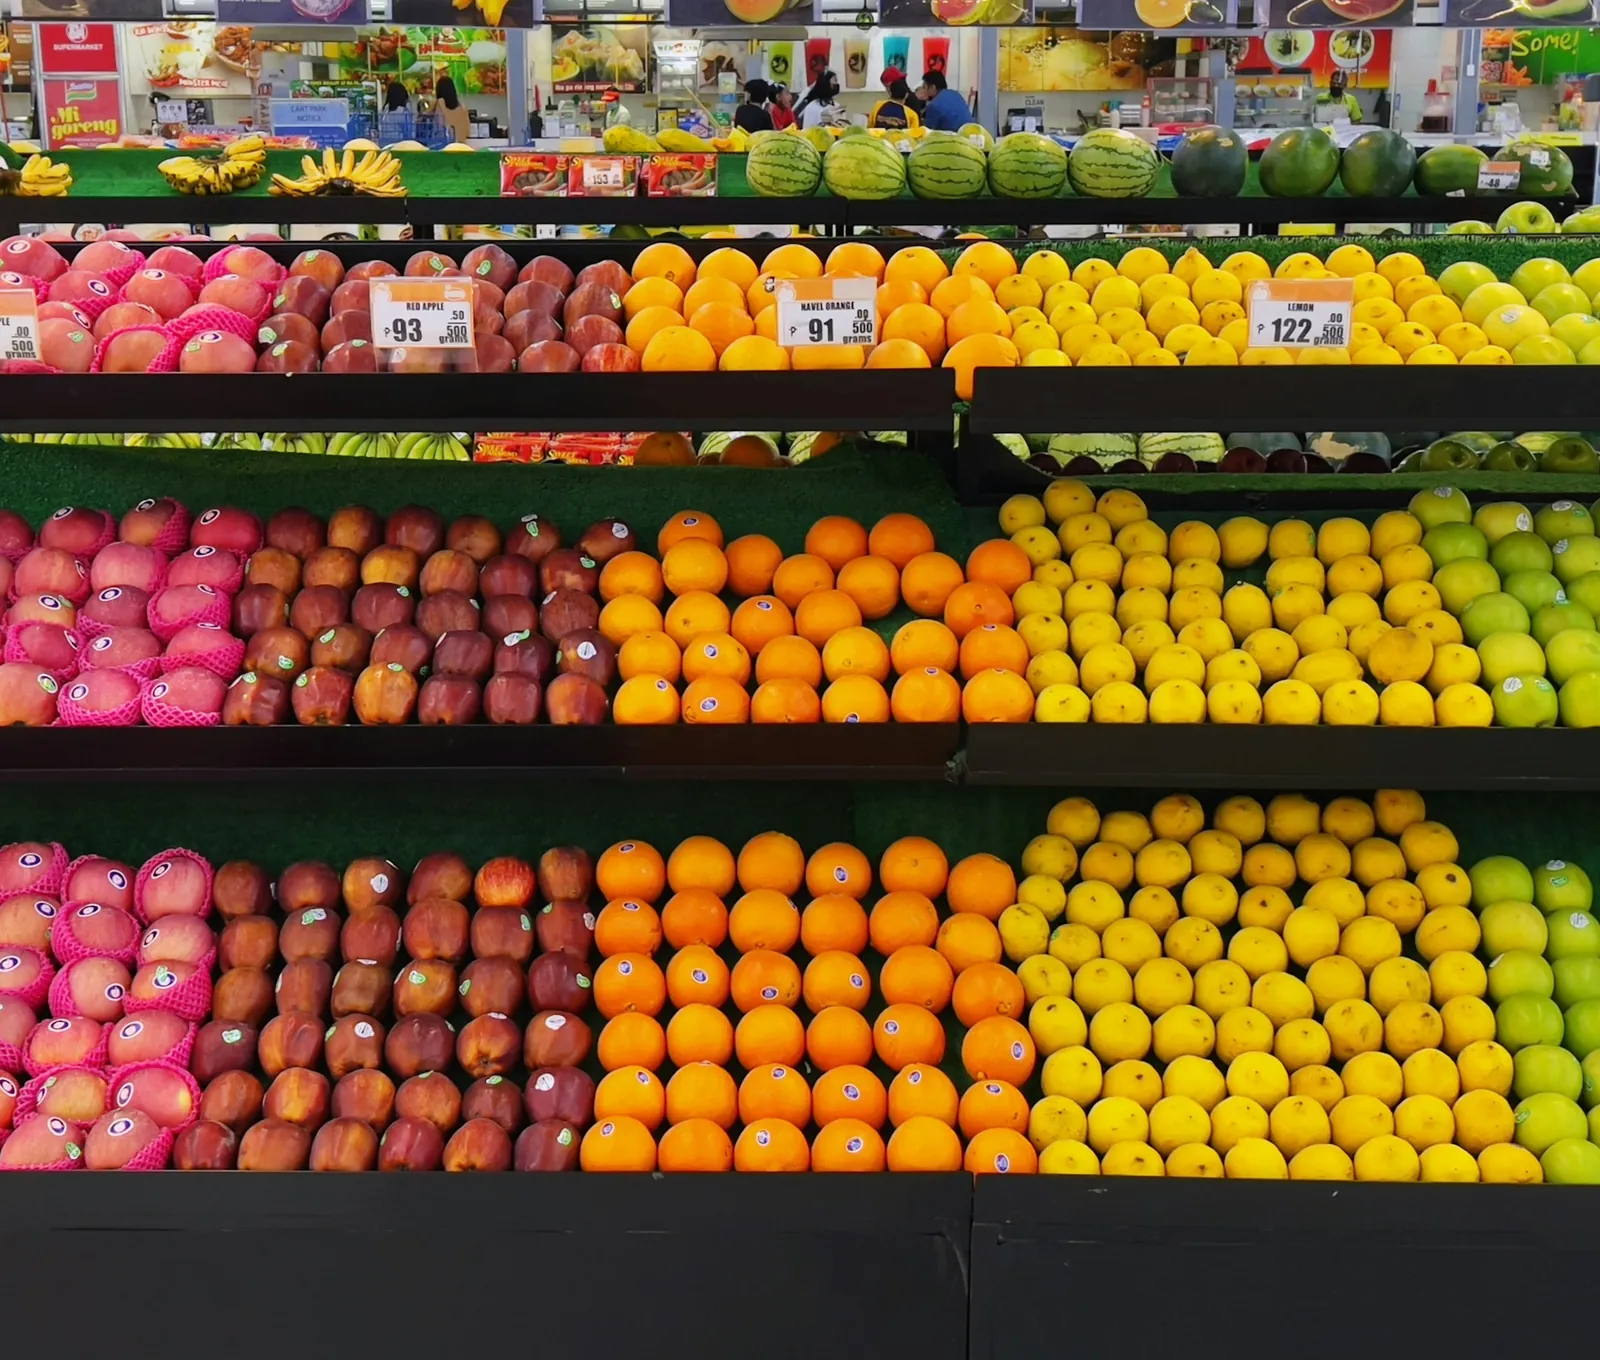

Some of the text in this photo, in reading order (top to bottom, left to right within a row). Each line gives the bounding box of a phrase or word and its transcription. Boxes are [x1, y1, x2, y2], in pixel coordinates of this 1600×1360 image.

[53, 43, 103, 51] SUPERMARKET
[1511, 30, 1580, 56] Some!
[51, 105, 80, 124] Mi
[52, 119, 118, 140] goreng
[593, 174, 609, 185] 153
[406, 302, 444, 311] RED APPLE
[801, 301, 855, 311] NAVEL ORANGE
[1288, 303, 1314, 312] LEMON
[0, 317, 10, 326] LE
[392, 318, 423, 342] 93
[446, 325, 467, 337] 500
[809, 318, 834, 342] 91
[853, 322, 873, 333] 500
[1271, 317, 1312, 343] 122
[1322, 326, 1344, 338] 500
[439, 334, 468, 344] grams
[843, 335, 872, 344] grams
[1313, 335, 1344, 346] grams
[12, 340, 34, 351] 500
[5, 351, 36, 359] grams
